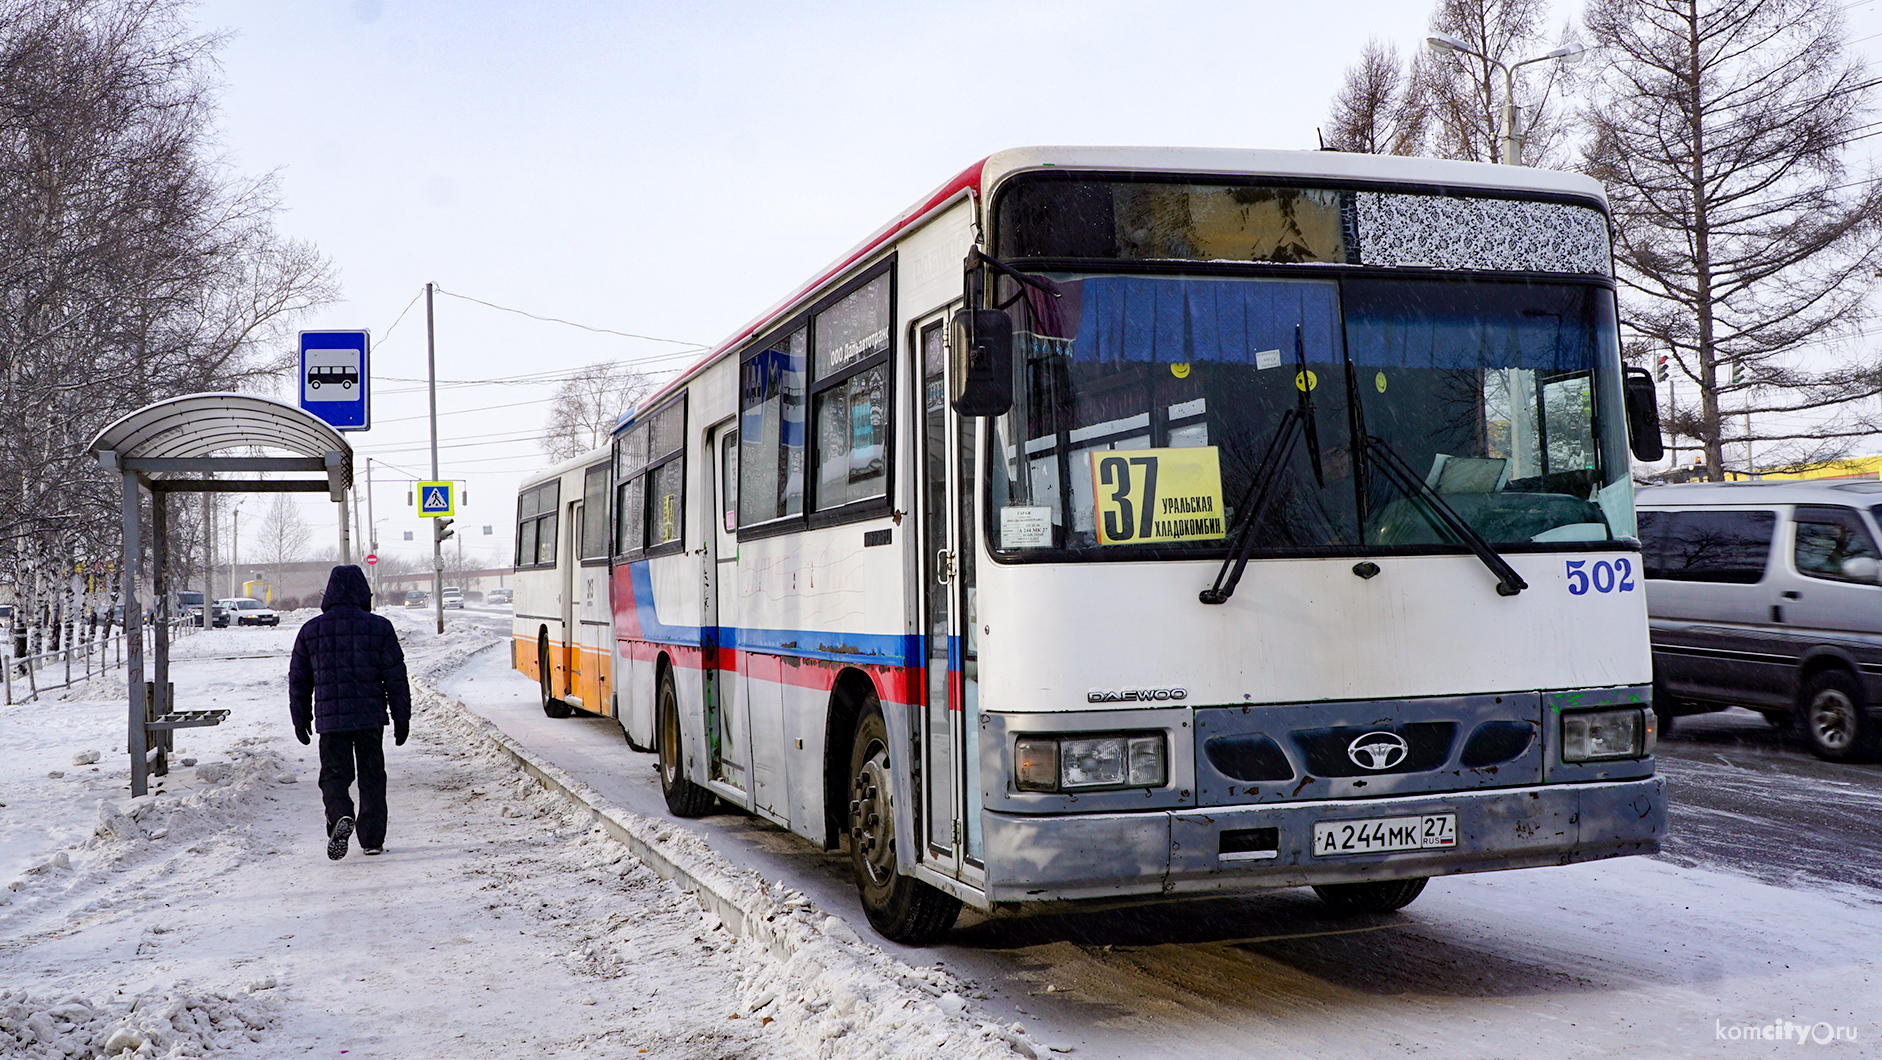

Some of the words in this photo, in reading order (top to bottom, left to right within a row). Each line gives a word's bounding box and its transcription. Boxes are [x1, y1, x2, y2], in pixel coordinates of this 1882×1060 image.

[1099, 456, 1158, 541] 37
[1161, 496, 1214, 515] УРАЛЬСКАЯ
[1154, 518, 1224, 539] ХЛАДОКОМБИН.
[1566, 558, 1635, 595] 502
[1088, 688, 1188, 703] DAEWOO
[1424, 817, 1447, 837] 27
[1423, 837, 1440, 845] RUS
